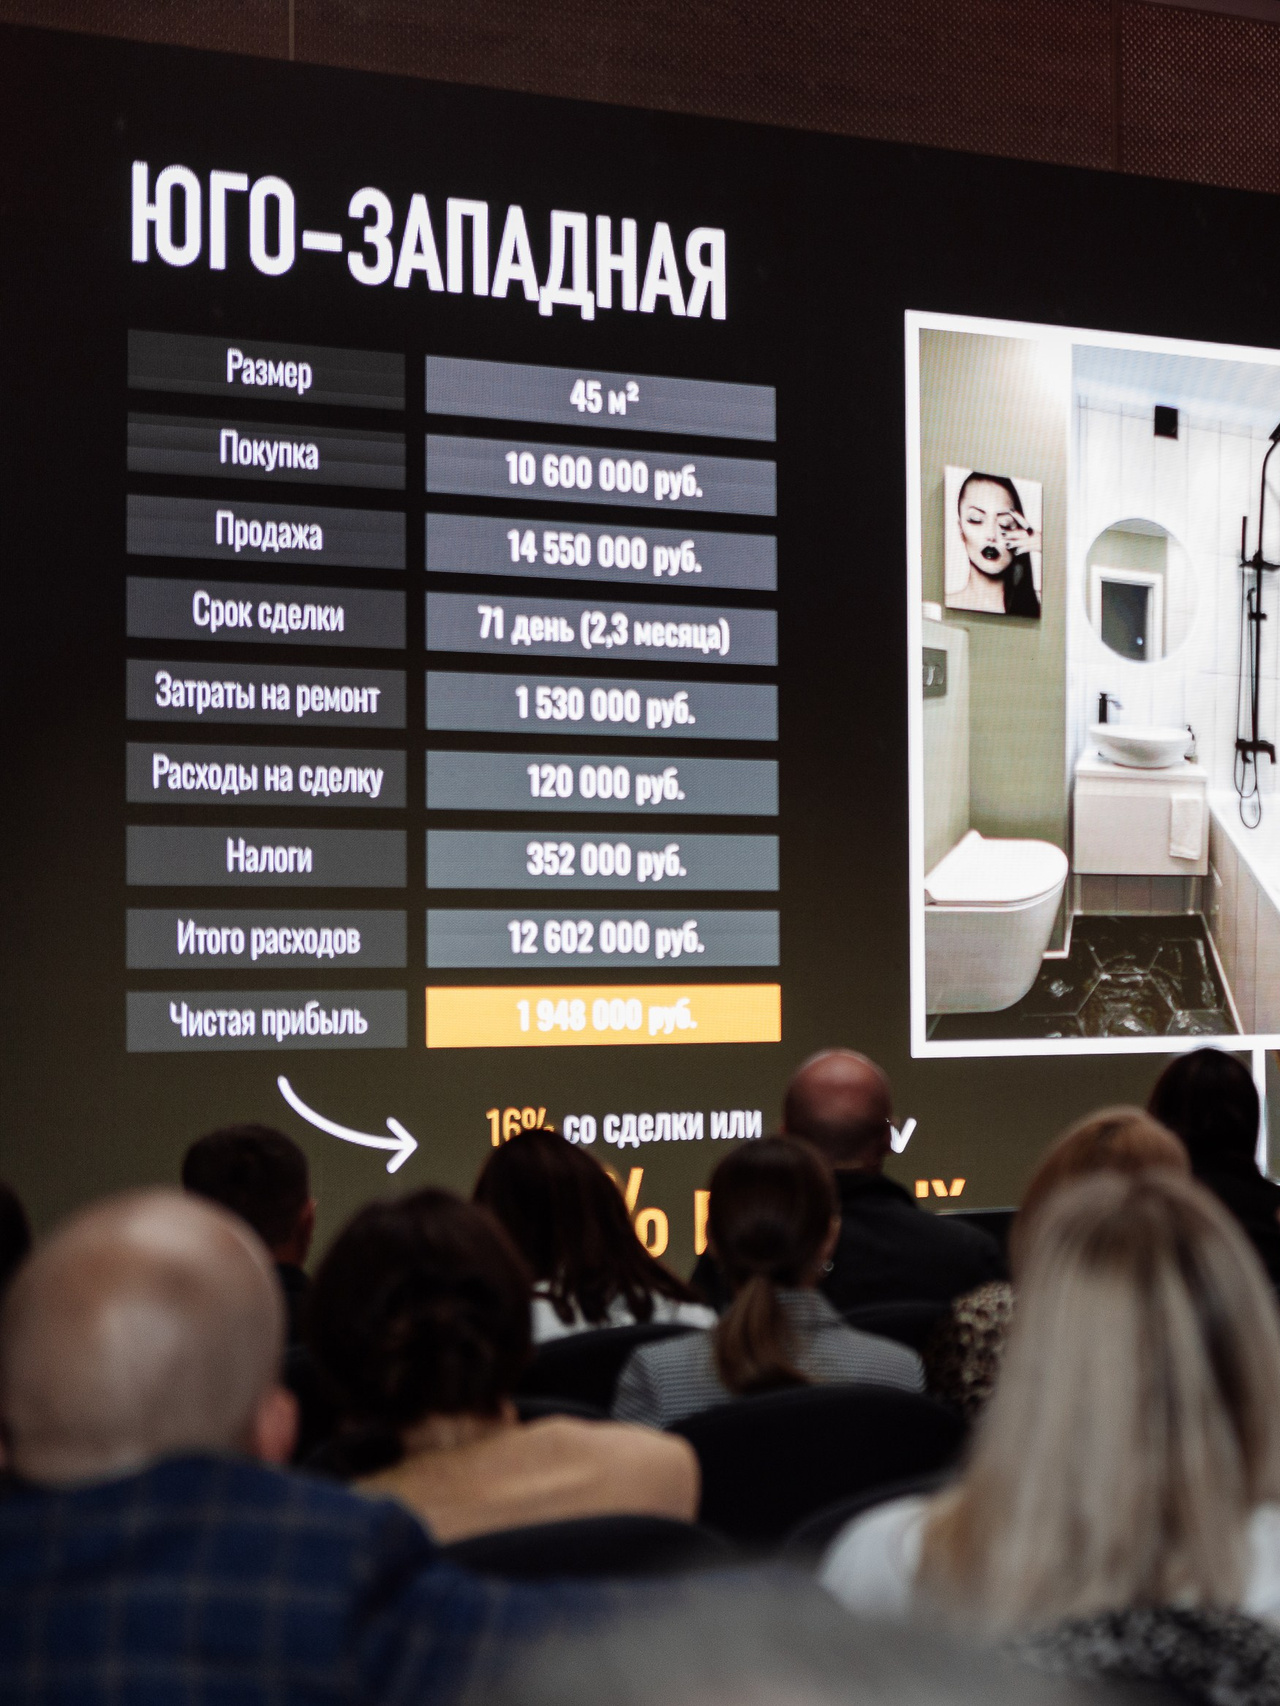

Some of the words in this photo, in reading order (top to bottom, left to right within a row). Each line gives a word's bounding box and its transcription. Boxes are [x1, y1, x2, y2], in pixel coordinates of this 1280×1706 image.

[131, 160, 727, 321] ЮГО-ЗАПАДНАЯ
[226, 348, 313, 395] Размер
[569, 379, 603, 414] 45
[220, 428, 319, 472] Покупка
[505, 450, 536, 486] 10
[542, 453, 593, 490] 600
[598, 457, 649, 494] 000
[654, 463, 703, 501] руб.
[215, 509, 323, 553] Продажа
[507, 529, 538, 564] 14
[543, 531, 592, 567] 550
[597, 534, 648, 570] 000
[653, 539, 703, 577] руб.
[192, 590, 253, 634] Срок
[257, 601, 345, 634] сделки
[477, 604, 504, 640] 71
[510, 614, 575, 646] день
[580, 610, 629, 650] (2,3
[633, 617, 730, 656] месяца)
[155, 670, 256, 715] Затраты
[261, 683, 291, 711] на
[296, 684, 381, 718] ремонт
[515, 685, 529, 719] 1
[535, 685, 585, 721] 530
[592, 687, 641, 723] 000
[646, 690, 696, 730] руб.
[152, 753, 259, 795] Расходы
[264, 764, 294, 792] на
[298, 765, 384, 799] сделку
[527, 763, 574, 798] 120
[579, 764, 631, 799] 000
[635, 767, 686, 806] руб.
[226, 837, 313, 873] Налоги
[526, 841, 576, 876] 352
[580, 842, 632, 877] 000
[637, 843, 687, 883] руб.
[177, 918, 245, 955] Итого
[250, 927, 361, 961] расходов
[507, 919, 539, 954] 12
[543, 920, 595, 954] 602
[599, 920, 650, 954] 000
[655, 919, 705, 960] руб.
[169, 1001, 256, 1037] Чистая
[261, 1000, 368, 1043] прибыль
[516, 999, 530, 1032] 1
[535, 998, 587, 1032] 948
[591, 997, 643, 1031] 000
[647, 996, 698, 1037] руб.
[563, 1114, 597, 1145] со
[603, 1111, 704, 1149] сделки
[710, 1110, 763, 1140] или
